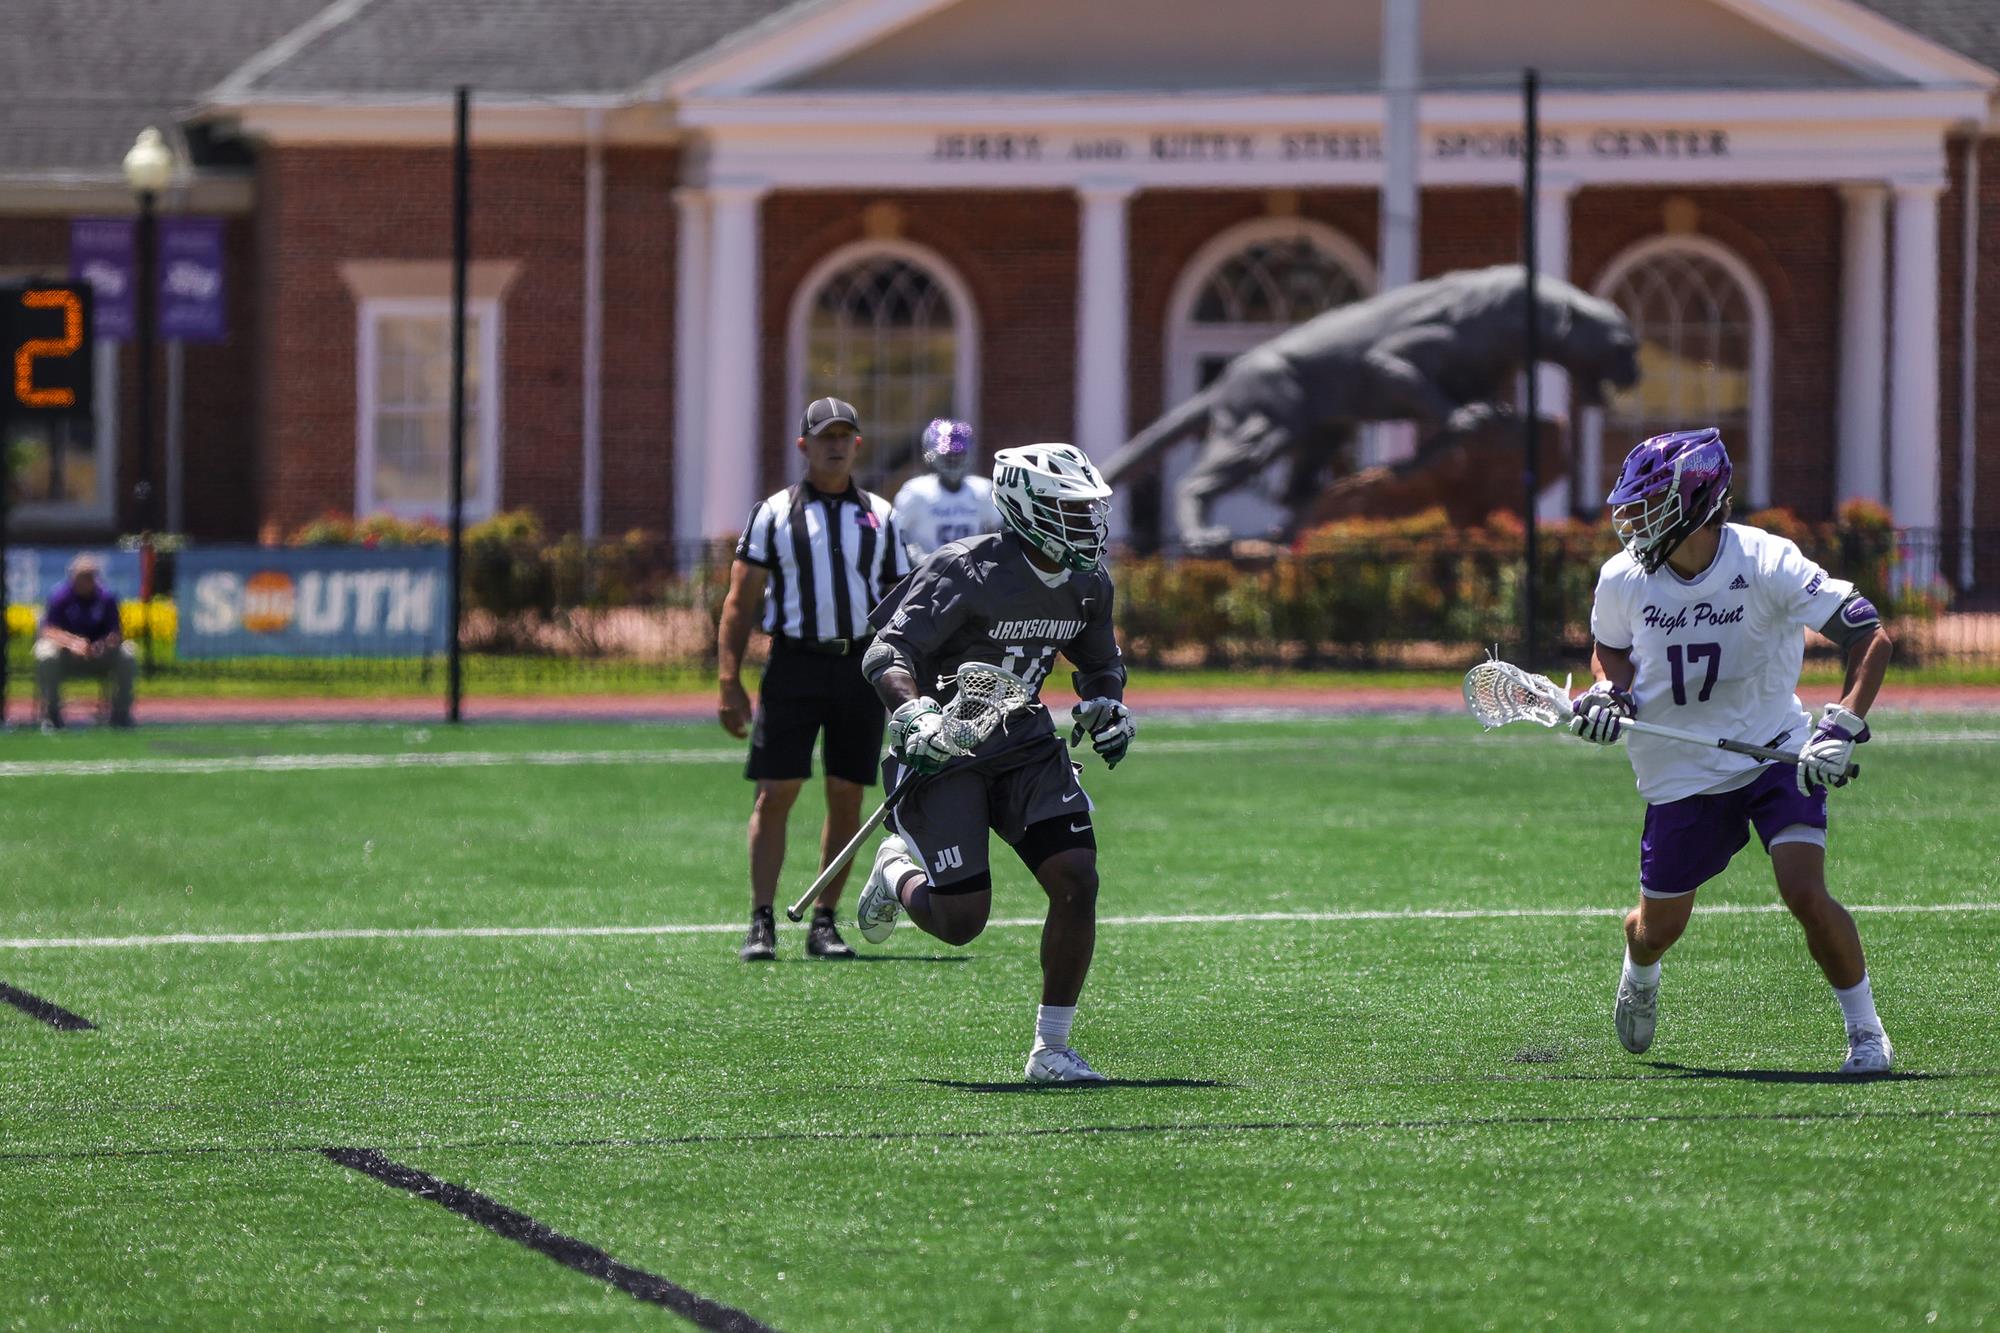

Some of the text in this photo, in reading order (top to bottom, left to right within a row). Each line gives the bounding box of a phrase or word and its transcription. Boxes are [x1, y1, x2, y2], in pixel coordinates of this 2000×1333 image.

[1281, 131, 1385, 161] STEEL
[1592, 130, 1729, 160] CENTER
[15, 289, 83, 408] 2
[997, 467, 1021, 488] JU
[1642, 602, 1745, 636] High Point
[1666, 642, 1722, 706] 17
[934, 844, 963, 873] JU
